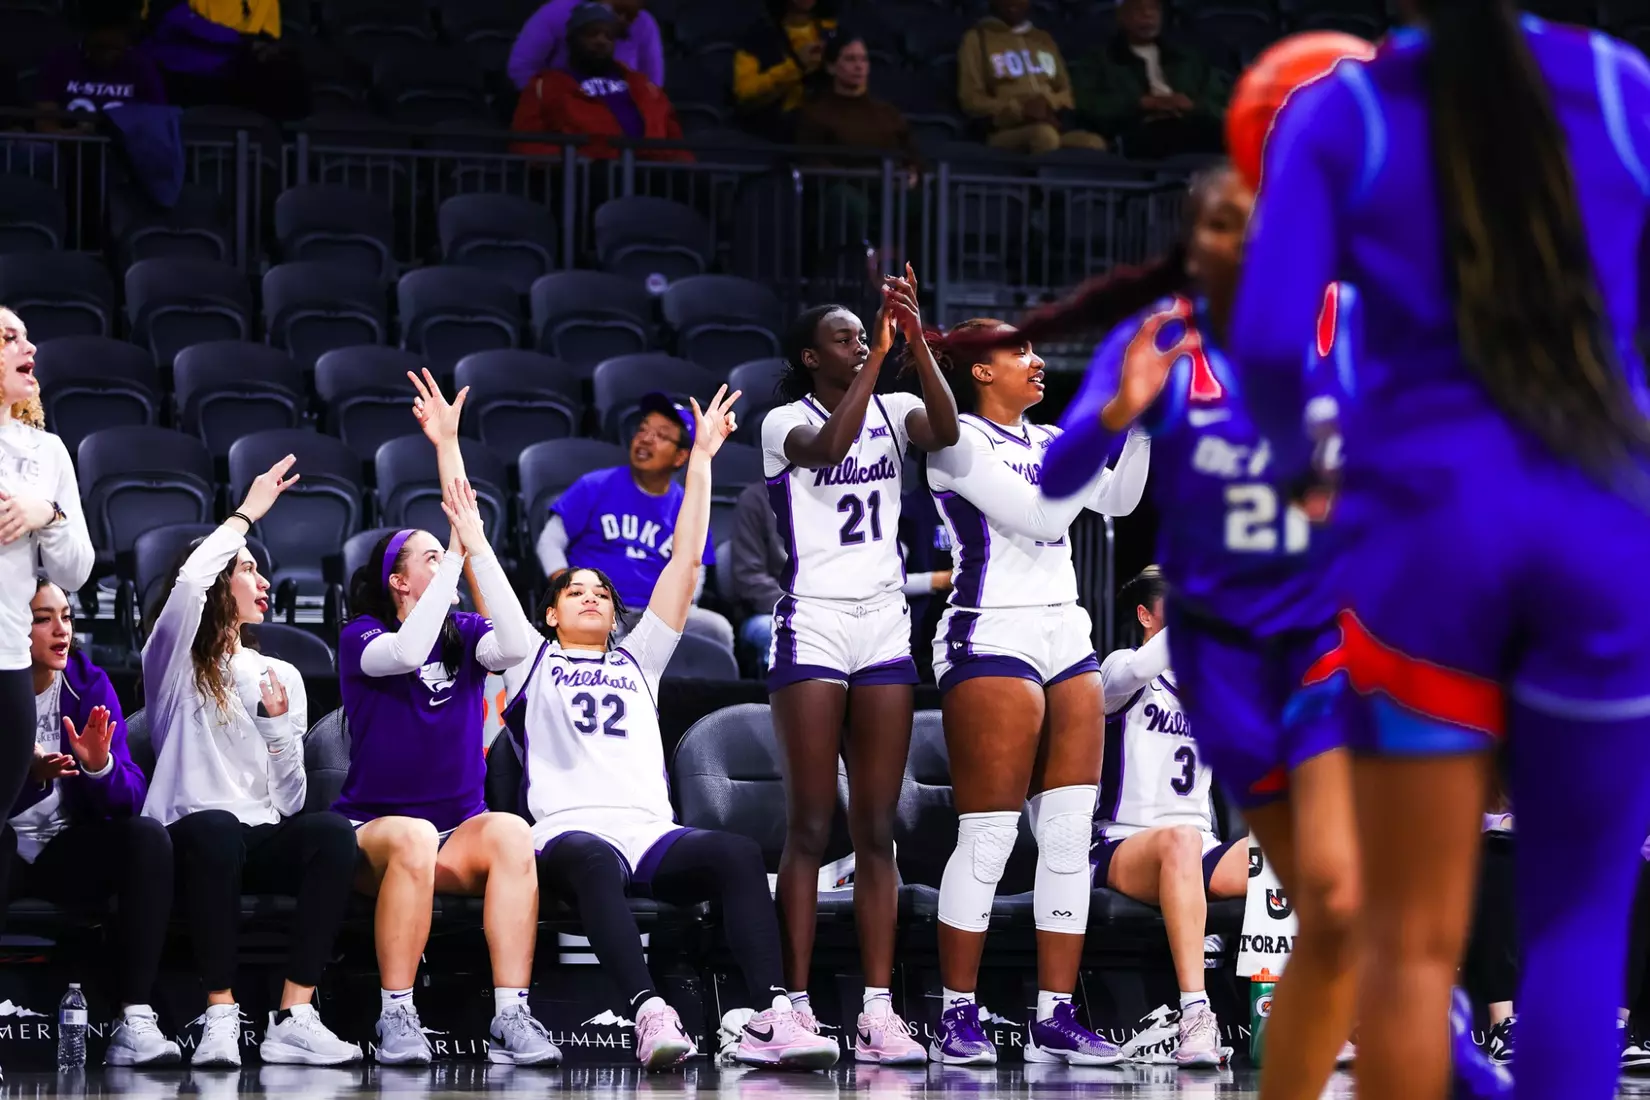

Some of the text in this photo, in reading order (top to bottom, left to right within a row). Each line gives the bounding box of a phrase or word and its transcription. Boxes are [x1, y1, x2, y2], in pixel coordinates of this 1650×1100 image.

[990, 49, 1057, 79] POLO
[65, 79, 135, 98] K-STATE
[809, 453, 896, 487] Wildcats
[837, 490, 883, 546] 21
[551, 666, 638, 693] Wildcats
[571, 692, 629, 740] 32
[1170, 744, 1196, 796] 3
